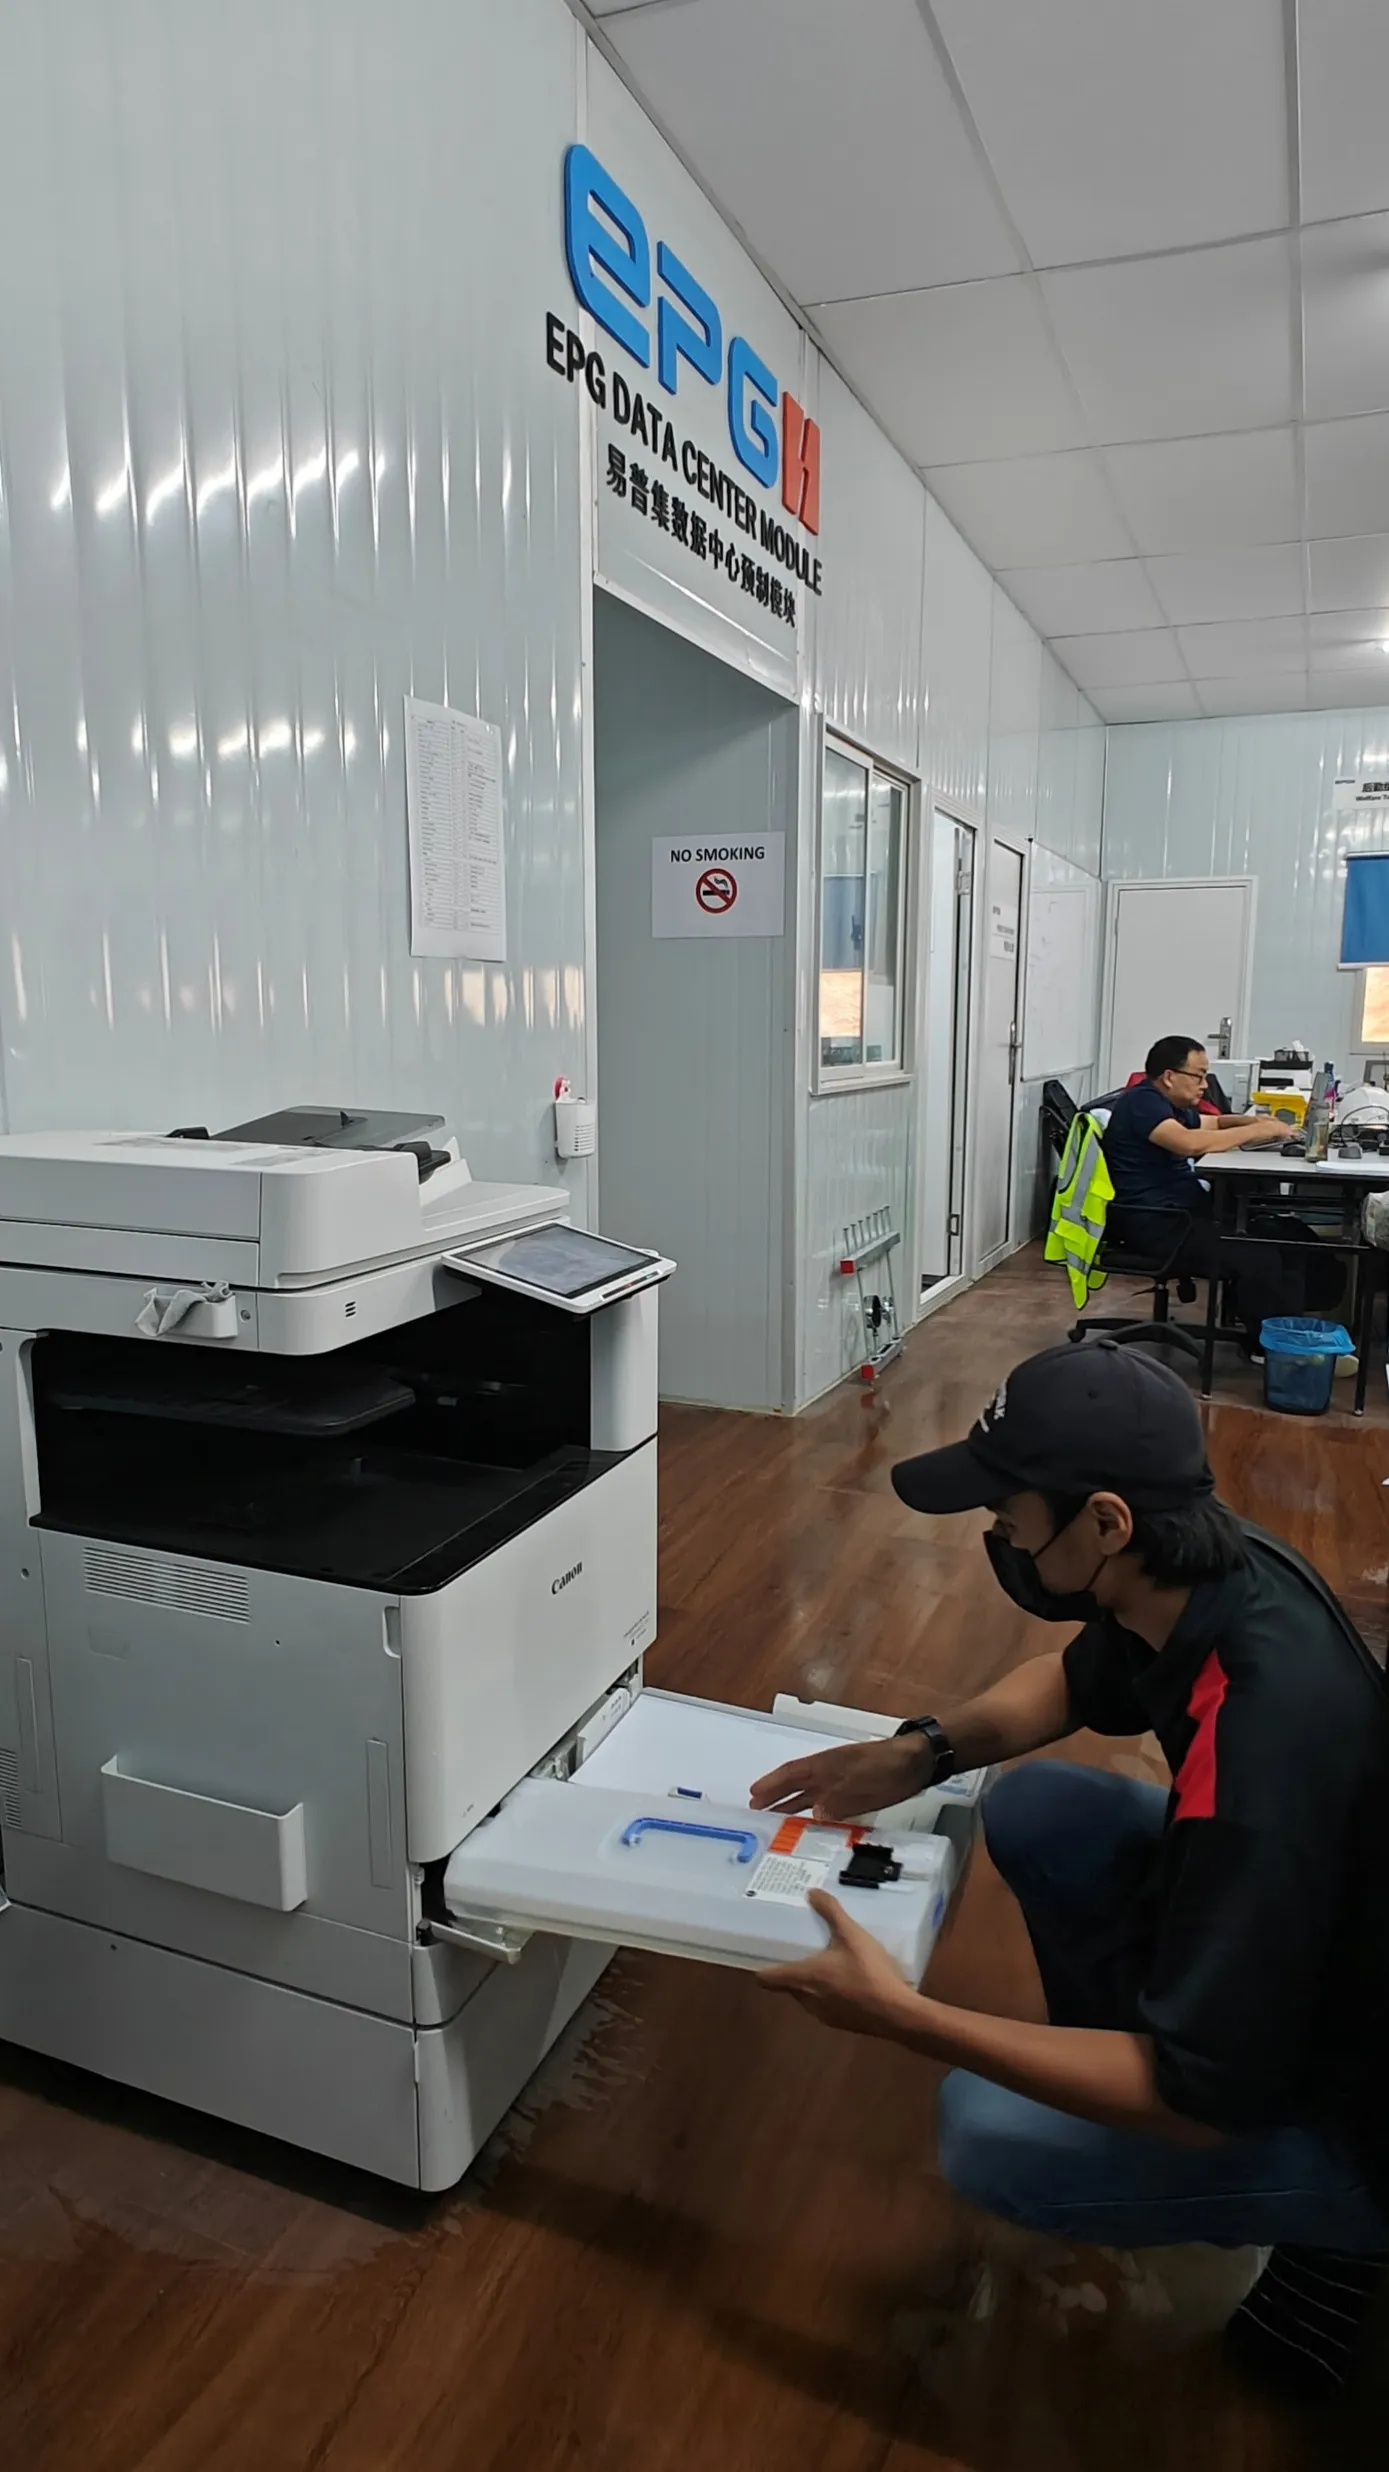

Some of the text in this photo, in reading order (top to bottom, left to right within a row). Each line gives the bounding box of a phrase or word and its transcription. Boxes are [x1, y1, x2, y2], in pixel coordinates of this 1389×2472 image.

[546, 311, 823, 597] EPG DATA CENTER MODULE
[605, 443, 796, 628] 易普集数据中心预制模块
[670, 846, 765, 863] NO SMOKING
[551, 1561, 582, 1595] Canon
